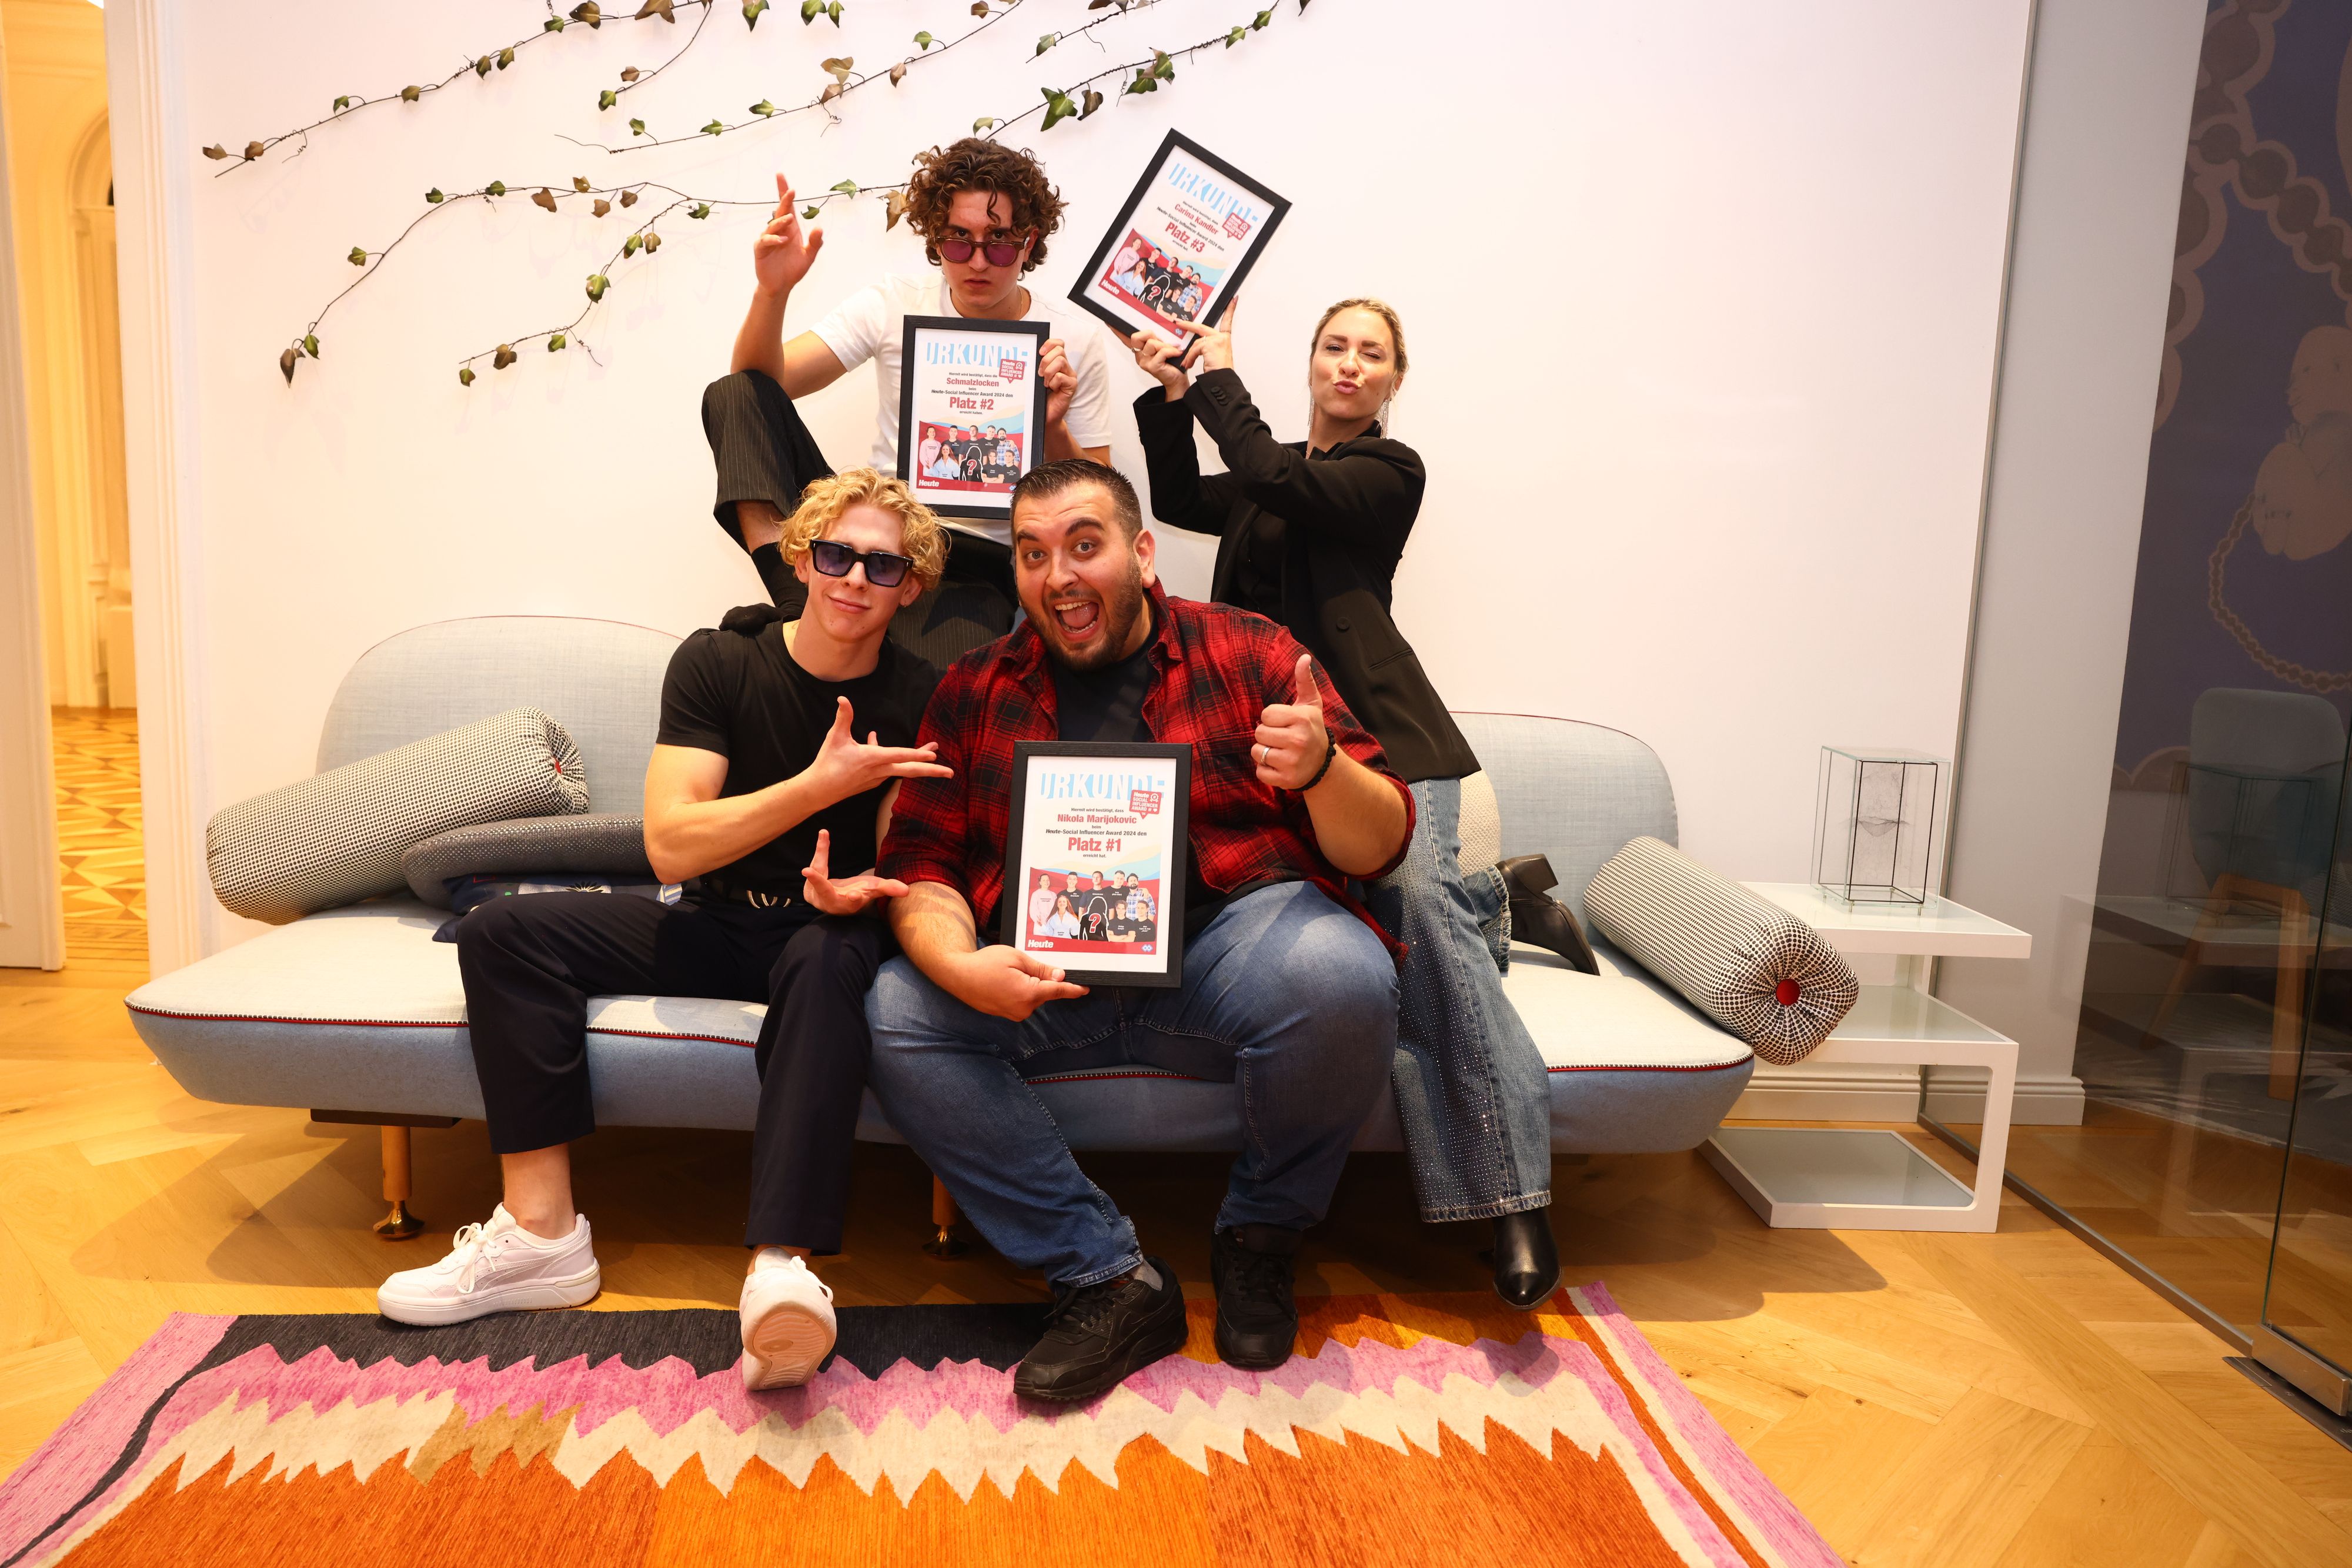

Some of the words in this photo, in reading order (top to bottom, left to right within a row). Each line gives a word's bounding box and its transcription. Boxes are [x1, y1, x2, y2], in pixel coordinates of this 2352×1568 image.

[1175, 203, 1194, 220] Carina
[1195, 216, 1218, 235] Kandler
[1165, 222, 1190, 244] Platz
[1190, 239, 1205, 253] #3
[1101, 279, 1120, 295] Heute
[947, 377, 999, 387] Schmalzlocken
[950, 396, 977, 409] Platz
[980, 399, 994, 410] #2
[1057, 814, 1084, 823] Nikola
[1087, 814, 1137, 825] Marijokovic
[1068, 837, 1101, 851] Platz
[1105, 838, 1121, 852] #1
[1028, 940, 1054, 948] Heute
